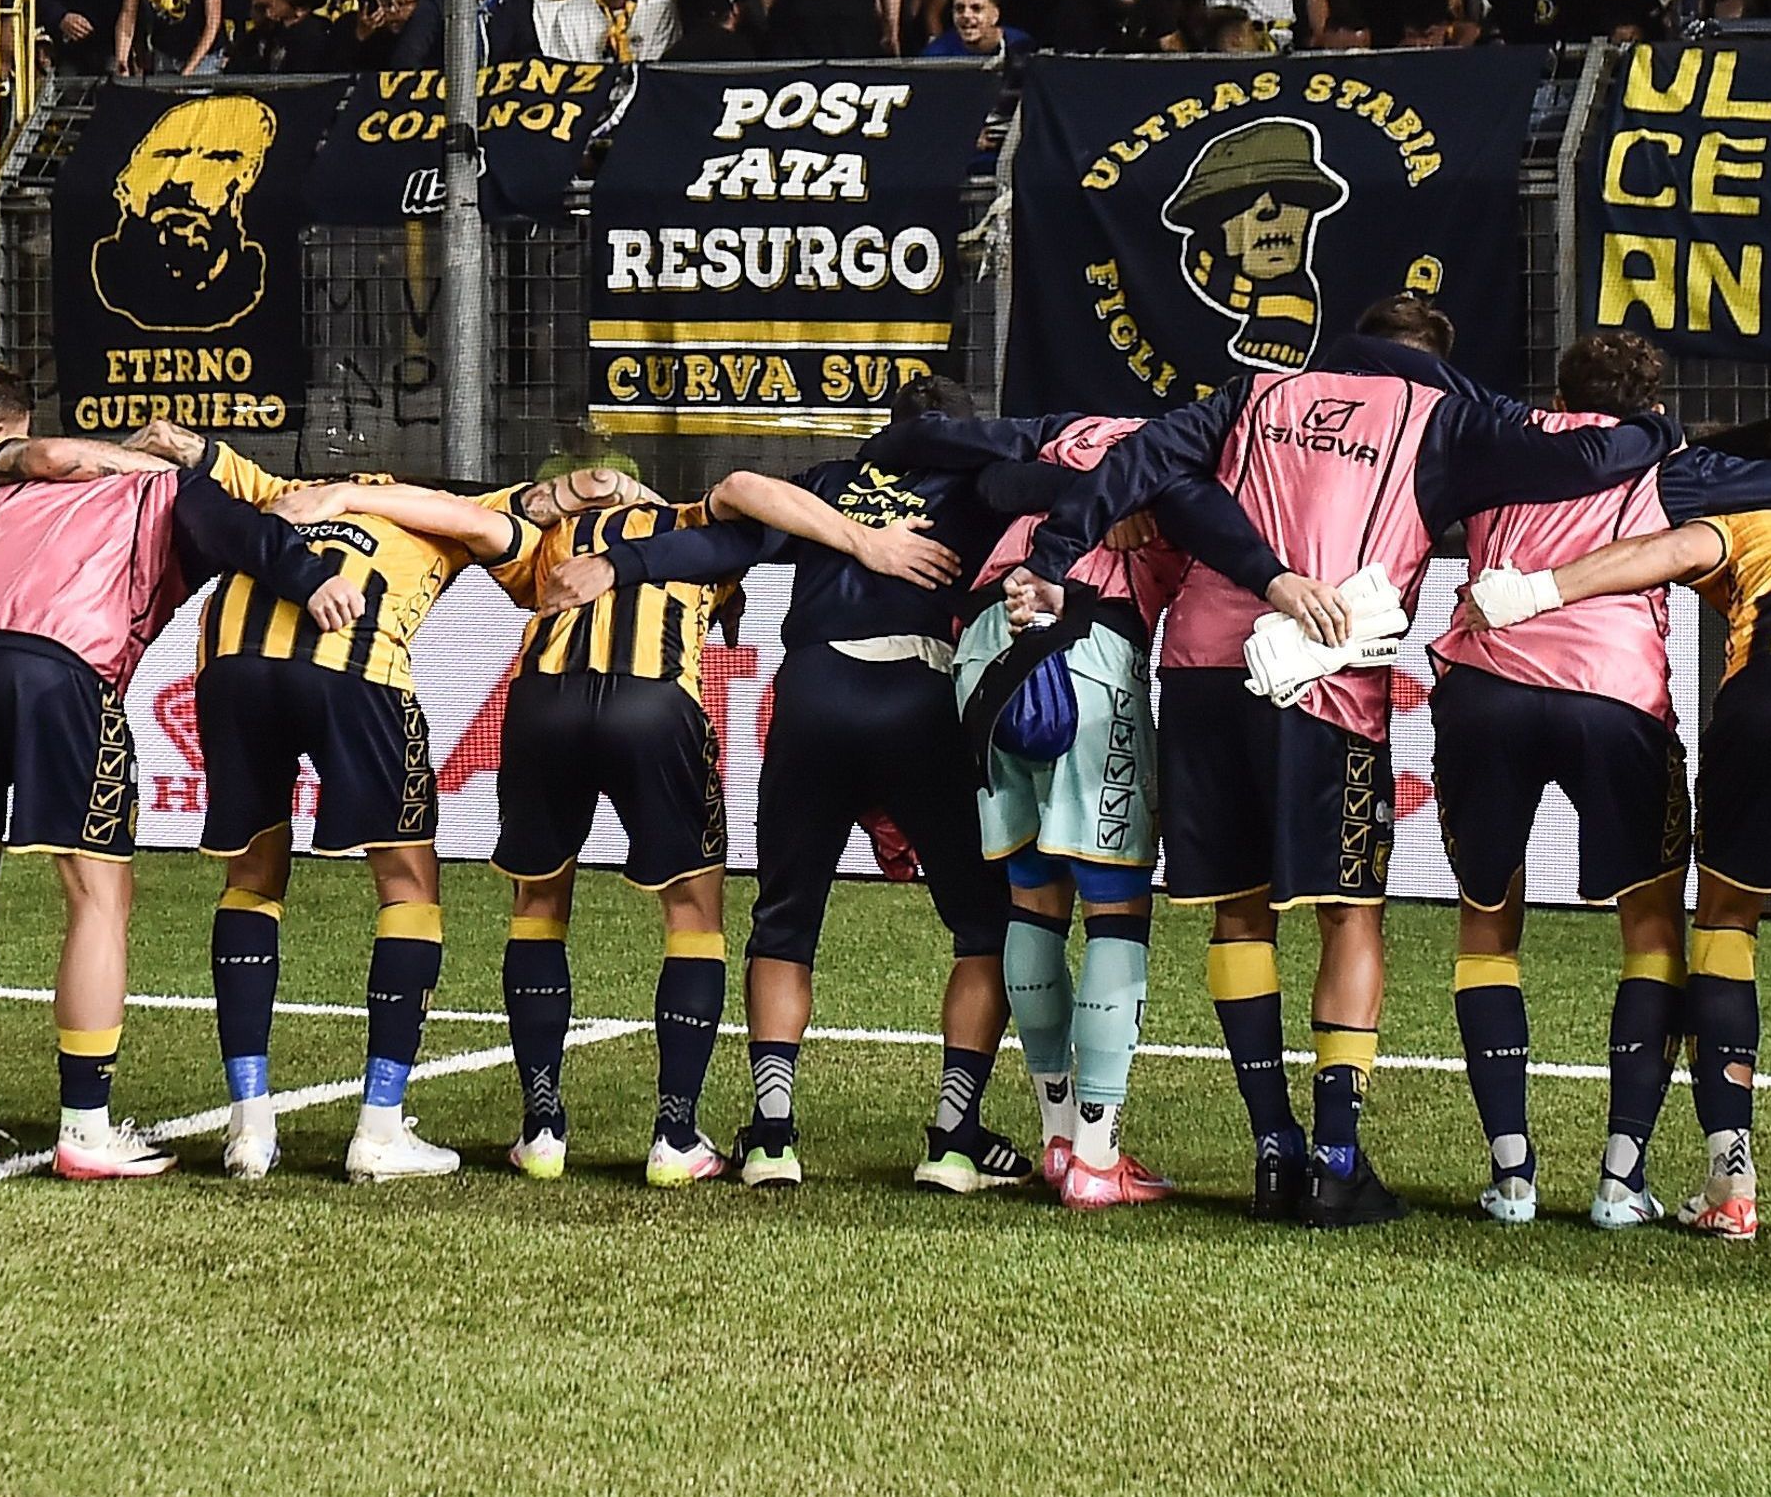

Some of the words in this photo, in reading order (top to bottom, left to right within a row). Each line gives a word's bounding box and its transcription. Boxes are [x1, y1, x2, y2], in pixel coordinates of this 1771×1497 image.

[712, 81, 911, 141] POST
[1080, 71, 1281, 192] ULTRAS
[1302, 72, 1445, 188] STABIA
[686, 151, 871, 203] FATA
[606, 224, 945, 294] RESURGO
[106, 347, 254, 388] ETERNO
[607, 352, 800, 404] CURVA
[74, 392, 287, 433] GUERRIERO
[1264, 424, 1379, 469] GIVOVA
